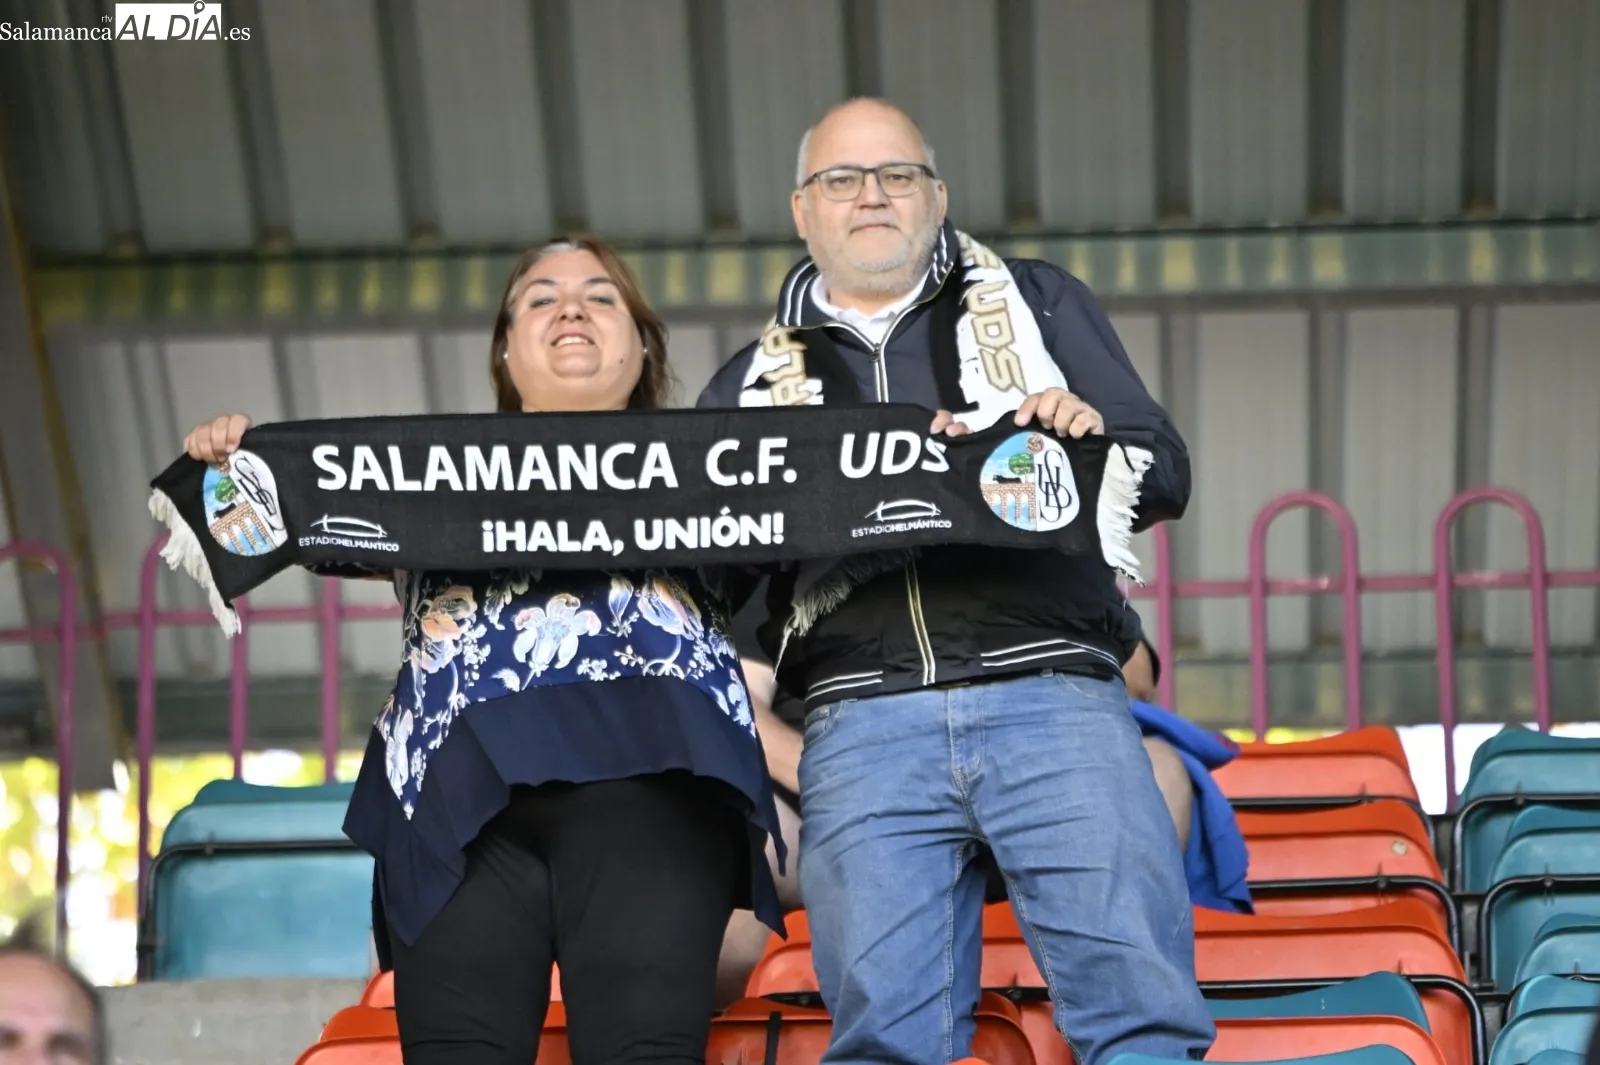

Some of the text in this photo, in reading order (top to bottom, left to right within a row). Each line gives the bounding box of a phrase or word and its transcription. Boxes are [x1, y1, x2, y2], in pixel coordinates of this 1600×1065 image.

[966, 280, 1028, 398] UDS
[312, 430, 950, 492] SALAMANCA C.F. UDS
[481, 506, 785, 557] ¡HALA, UNIÓN!
